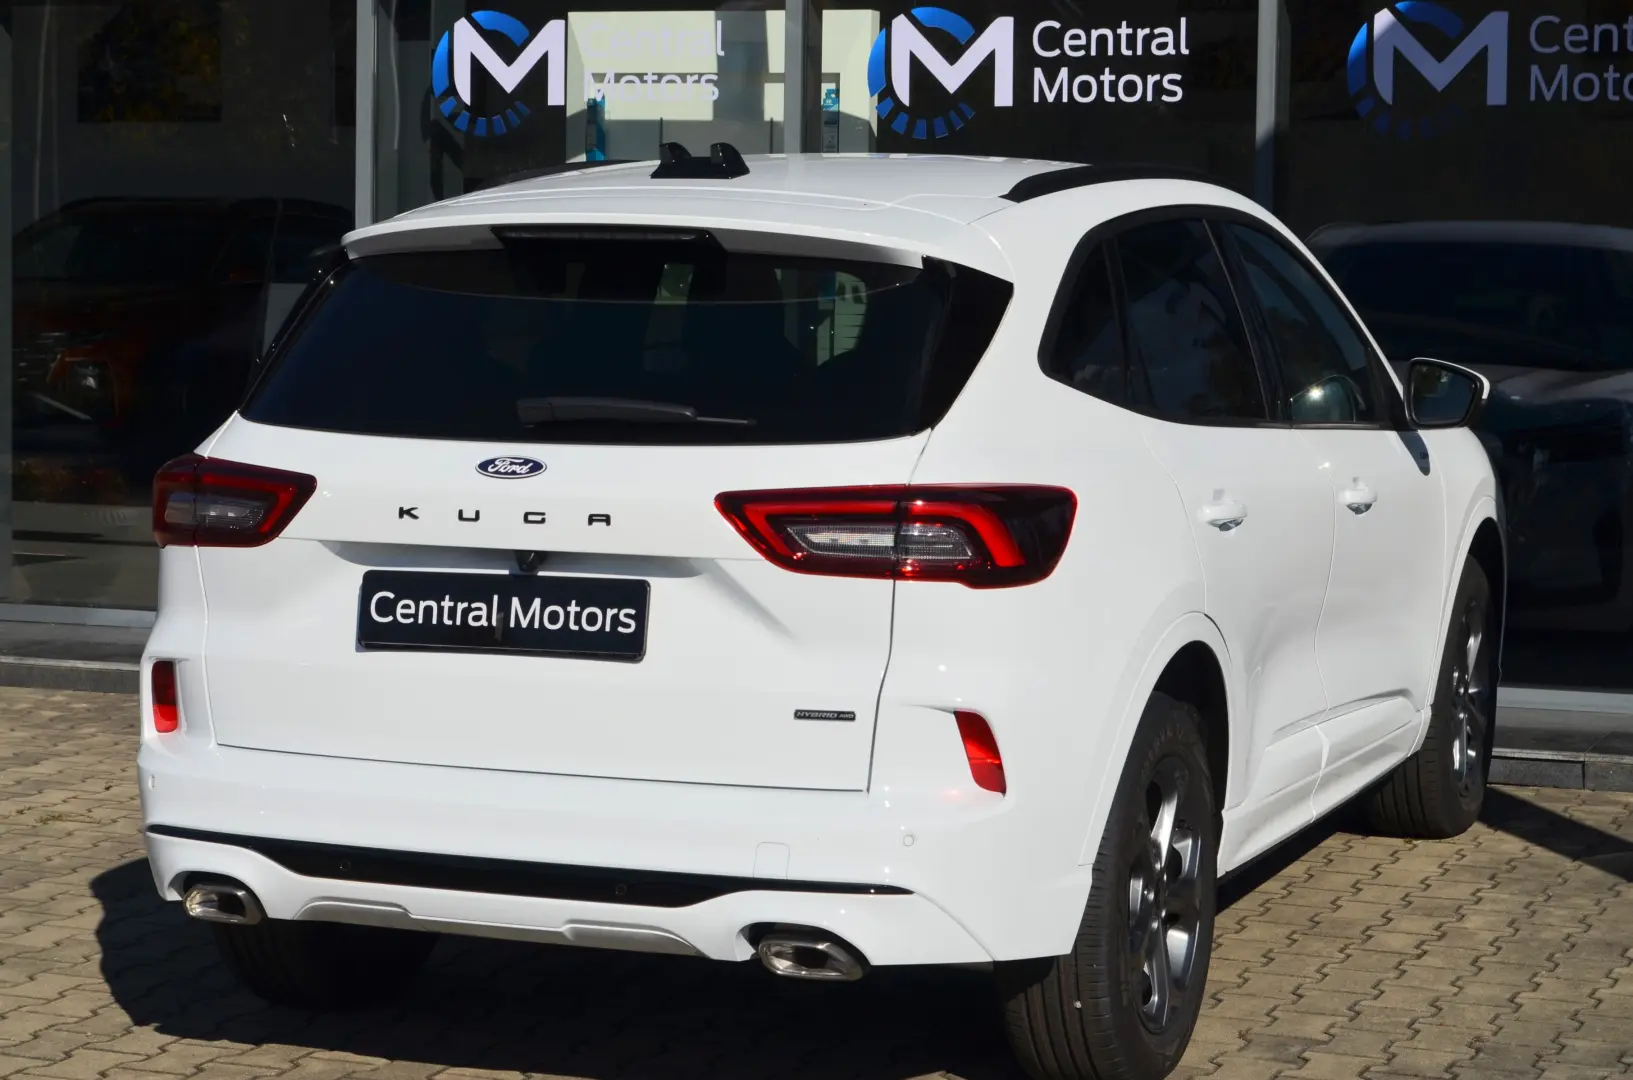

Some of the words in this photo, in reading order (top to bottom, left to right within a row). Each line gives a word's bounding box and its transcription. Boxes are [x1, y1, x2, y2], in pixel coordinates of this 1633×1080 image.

[583, 20, 725, 59] Central
[1032, 17, 1189, 57] Central
[583, 69, 720, 102] Motors
[1033, 66, 1184, 103] Motors
[487, 457, 534, 474] Ford
[398, 506, 612, 527] KUGA
[369, 591, 498, 628] Central
[509, 596, 637, 634] Motors
